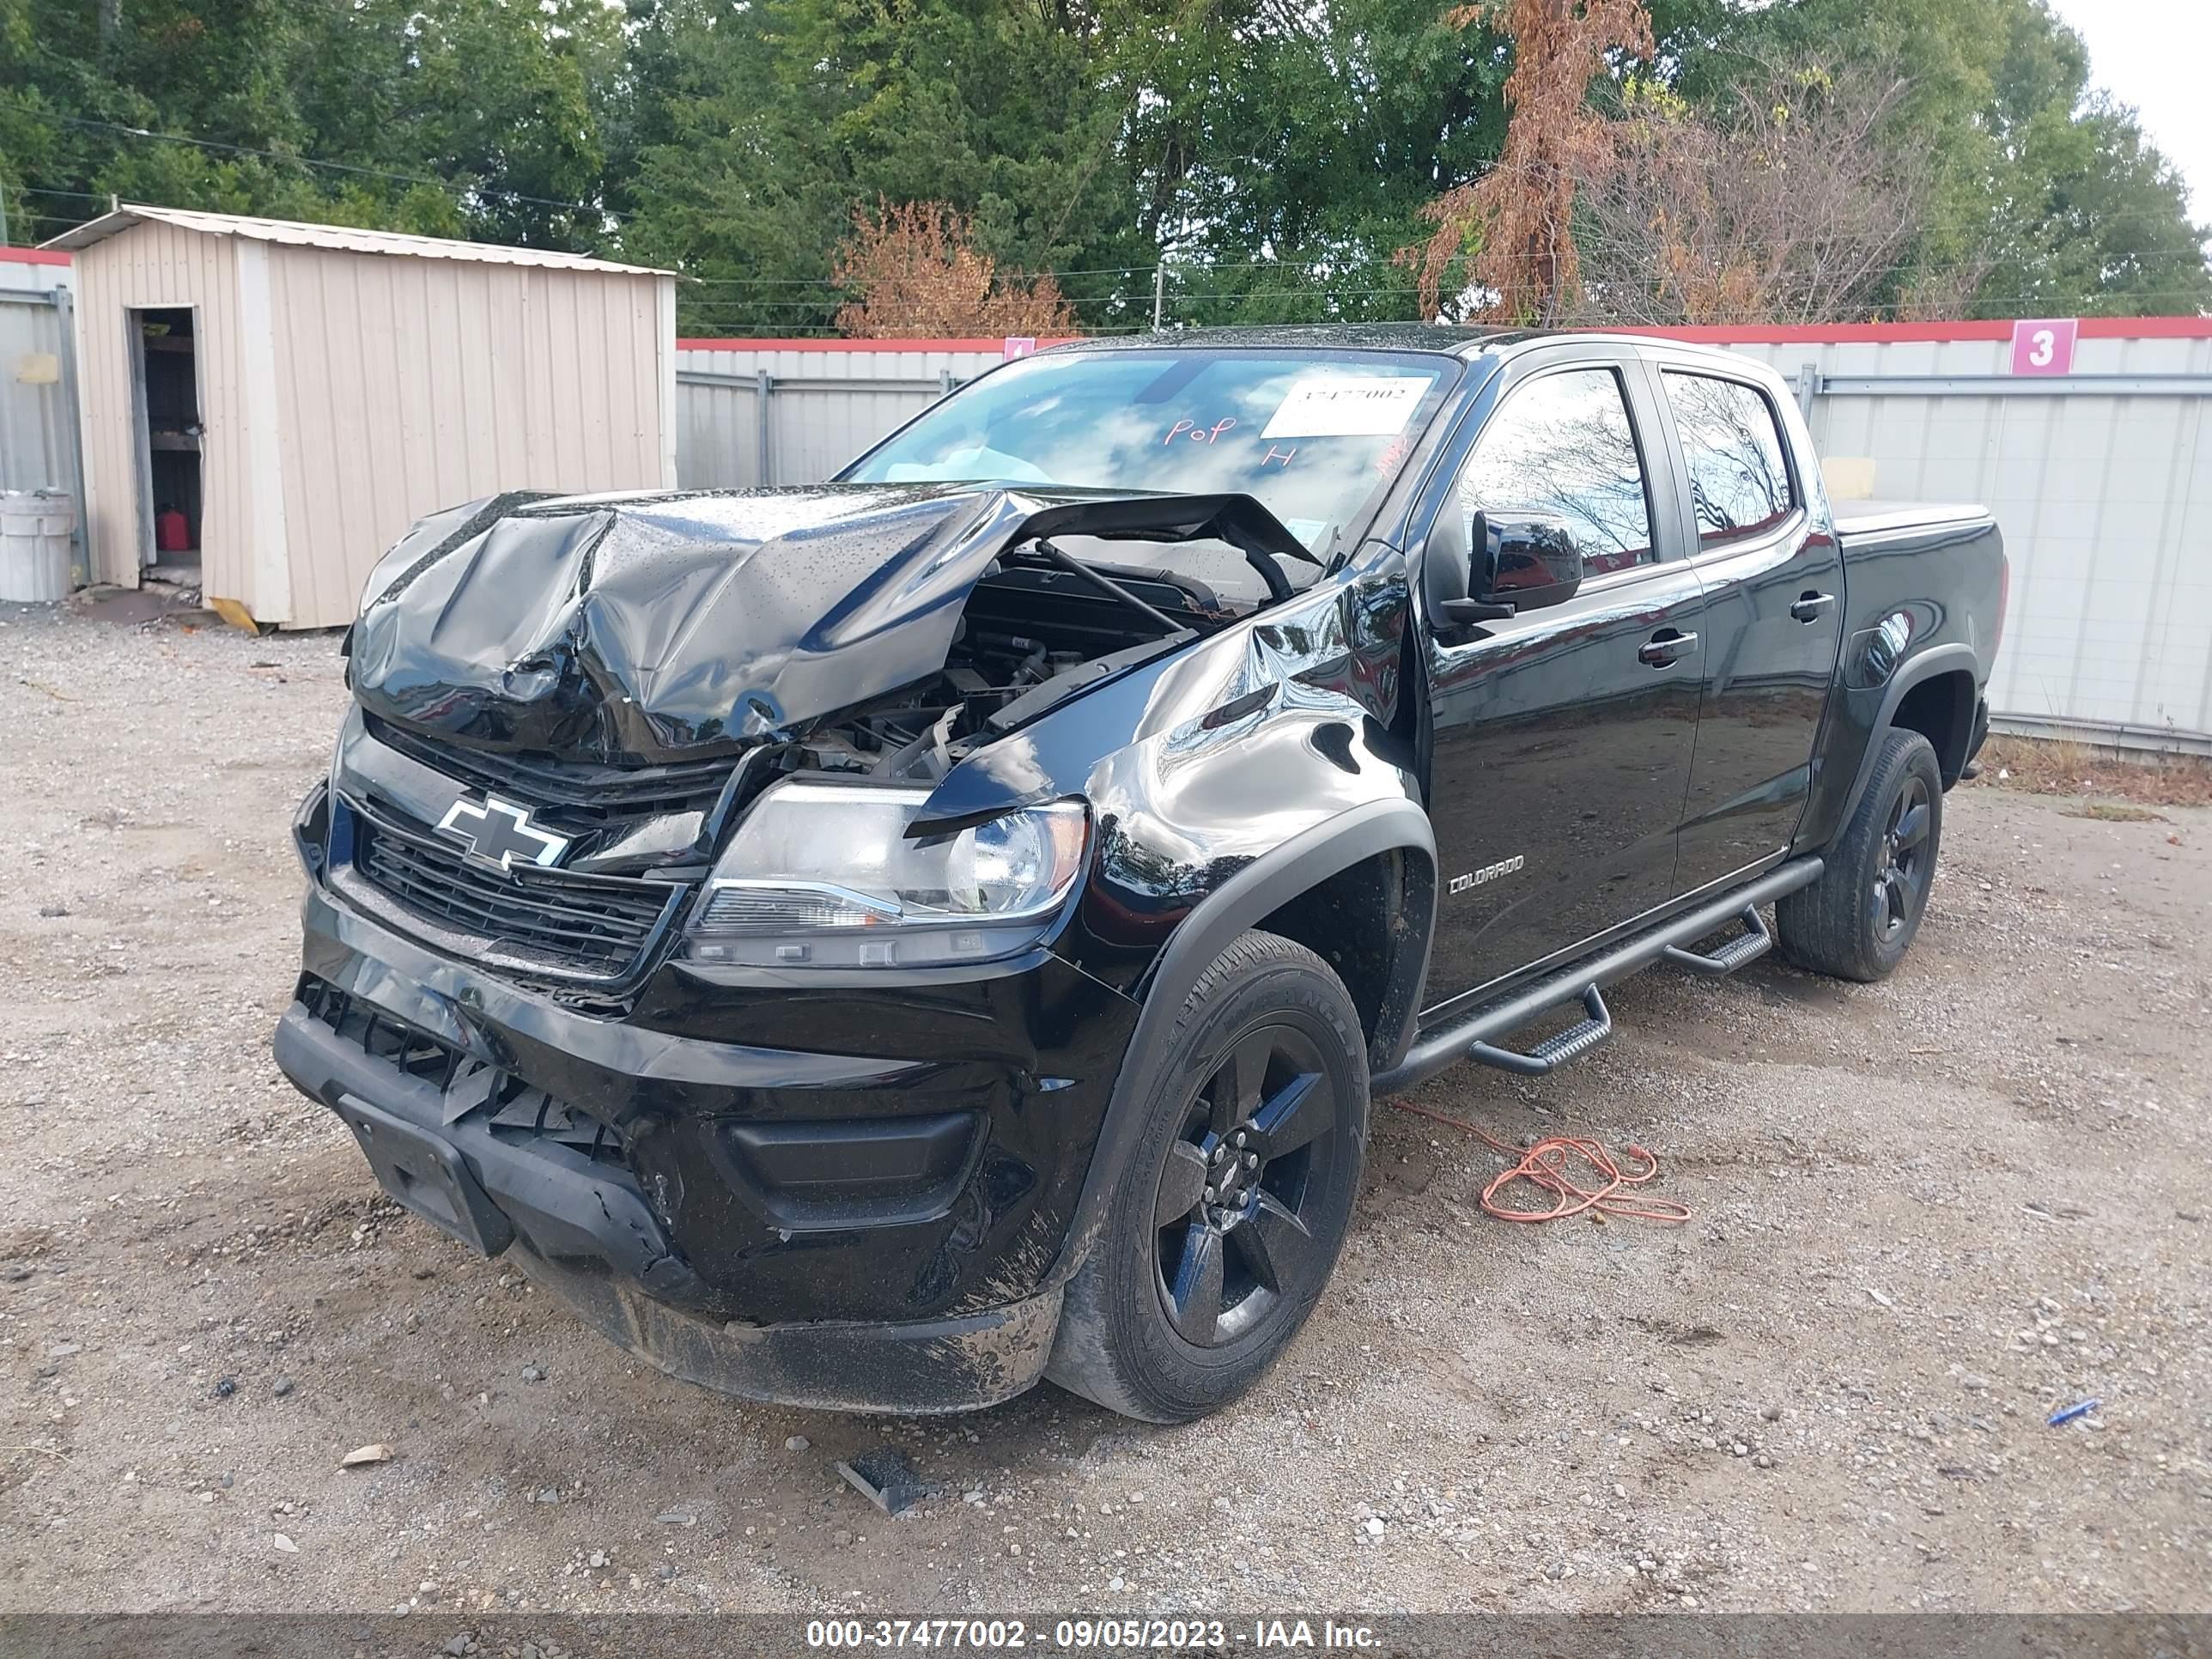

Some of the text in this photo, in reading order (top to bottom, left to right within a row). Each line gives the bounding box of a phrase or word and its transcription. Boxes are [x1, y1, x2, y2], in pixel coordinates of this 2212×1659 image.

[2029, 329, 2055, 367] 3
[1261, 445, 1297, 466] H
[1448, 854, 1524, 894] COLORADO
